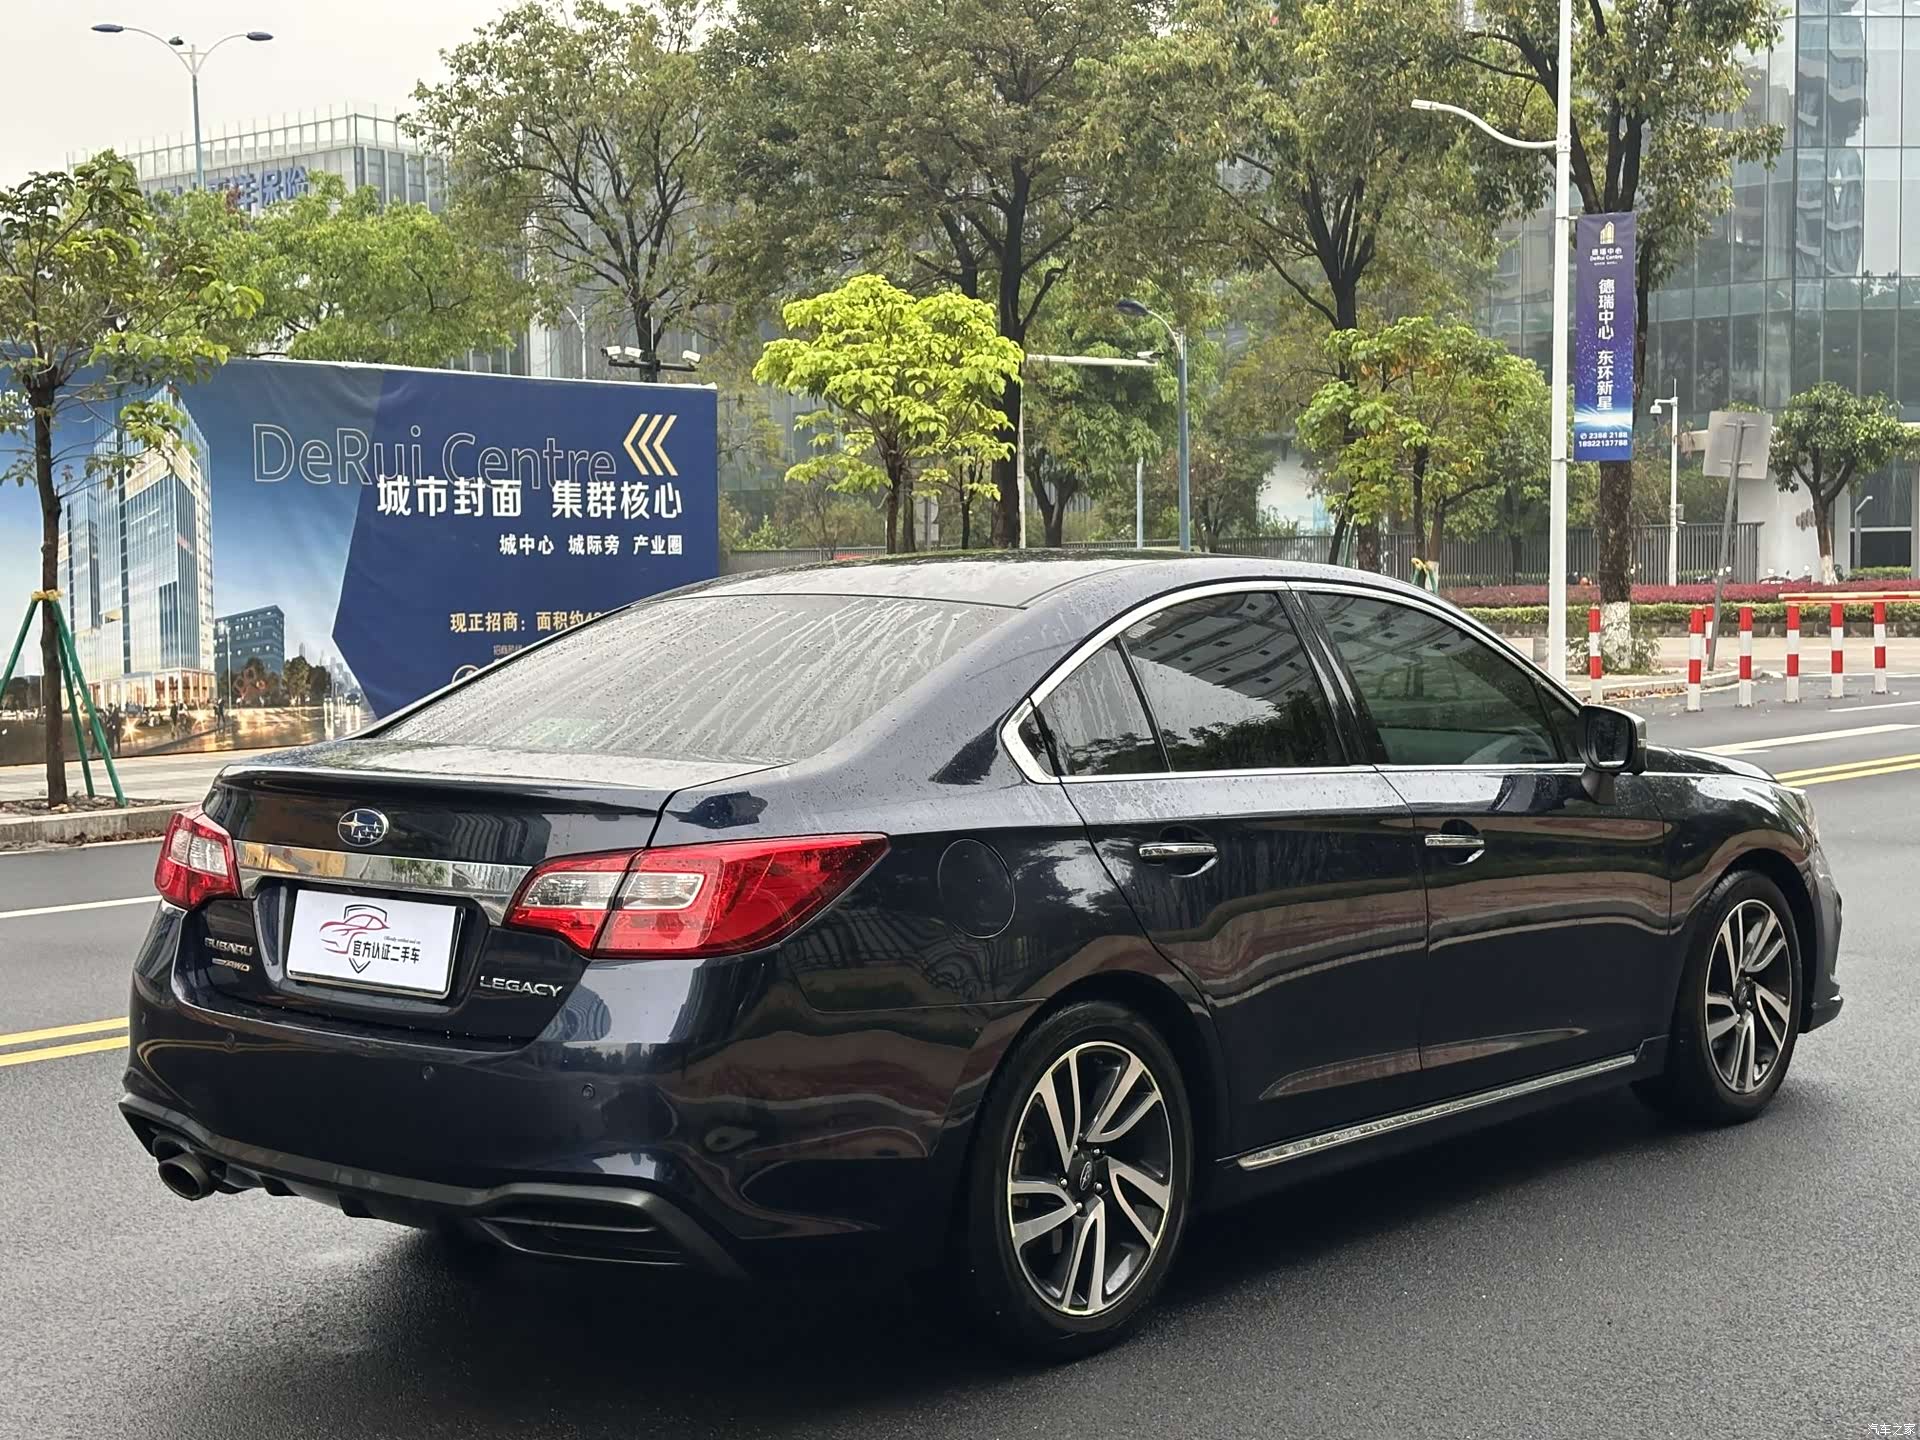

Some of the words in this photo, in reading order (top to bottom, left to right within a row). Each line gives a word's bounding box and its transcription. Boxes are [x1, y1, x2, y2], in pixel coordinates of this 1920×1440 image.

[1598, 278, 1615, 340] 德瑞中心
[1596, 349, 1614, 411] 东环新星
[252, 424, 424, 487] DeRui
[441, 431, 617, 489] Centre
[376, 474, 522, 518] 城市封面
[551, 478, 683, 519] 集群核心
[499, 532, 555, 556] 城中心
[567, 533, 620, 556] 城际旁
[632, 533, 683, 556] 产业圈
[204, 936, 253, 957] SUBARU
[353, 939, 421, 964] 官方认证二手车
[479, 975, 563, 997] LEGACY
